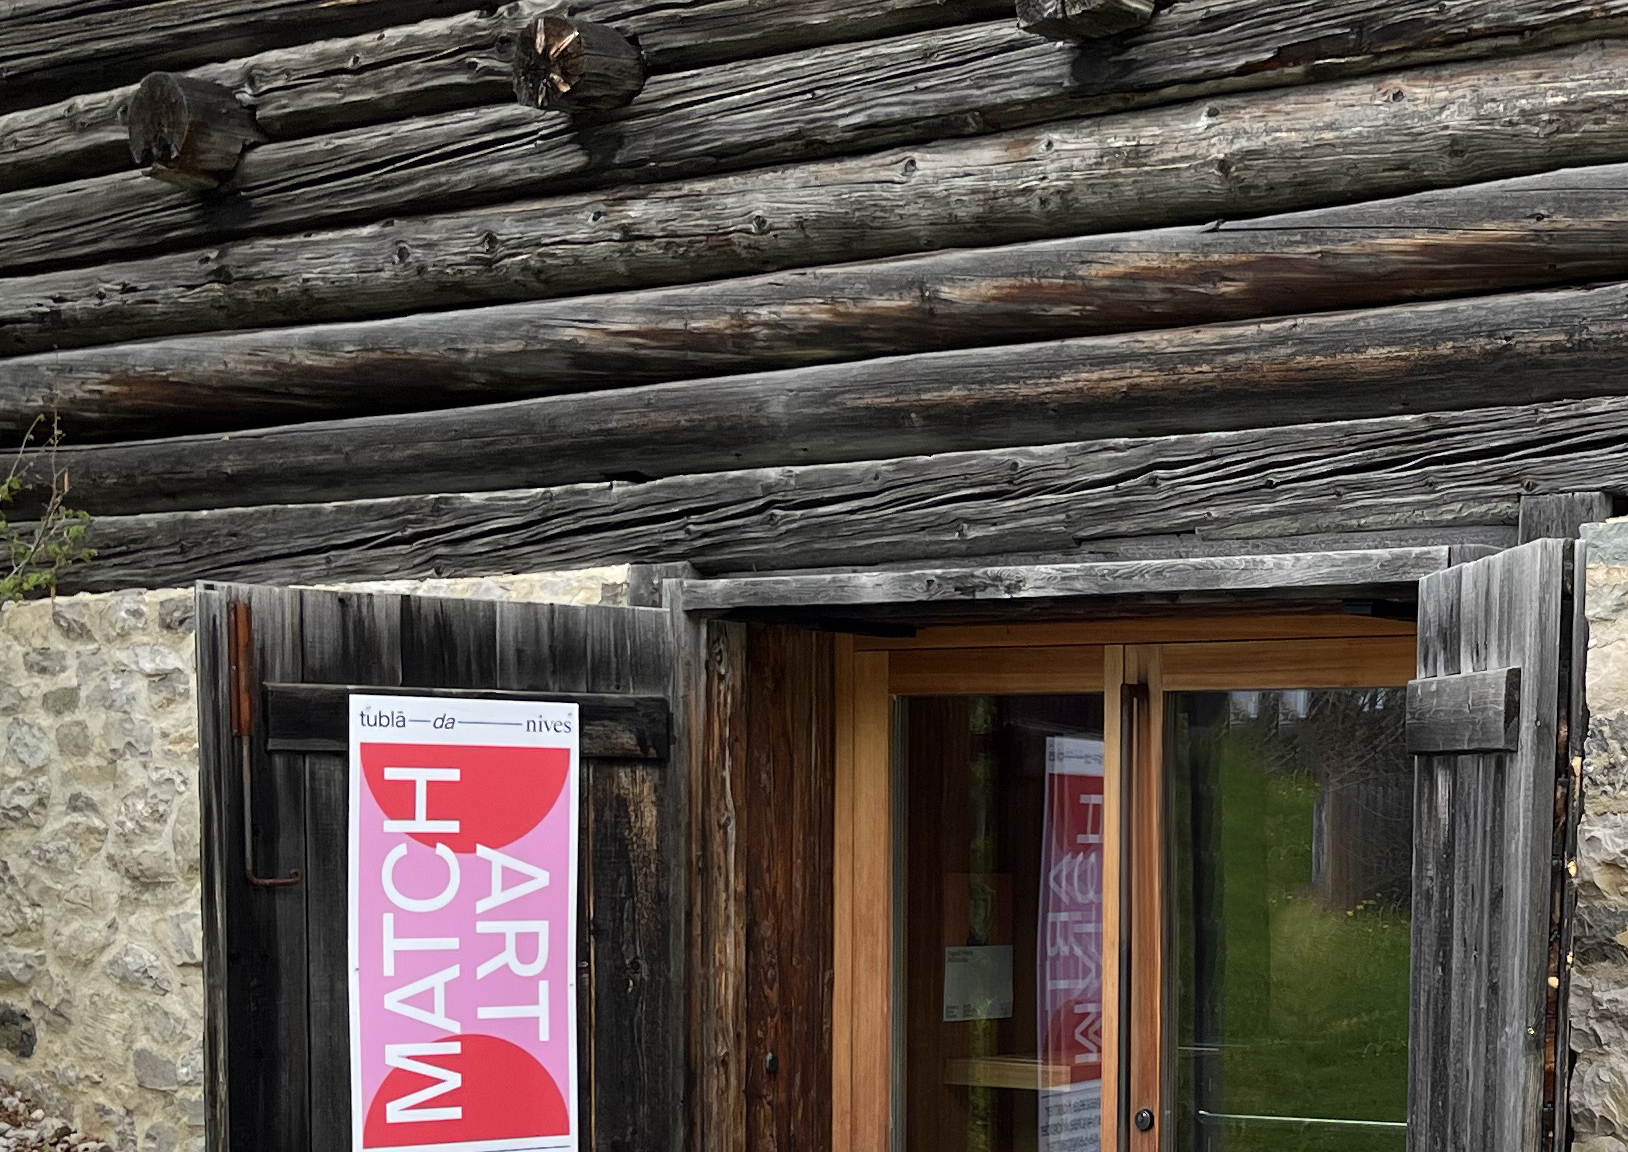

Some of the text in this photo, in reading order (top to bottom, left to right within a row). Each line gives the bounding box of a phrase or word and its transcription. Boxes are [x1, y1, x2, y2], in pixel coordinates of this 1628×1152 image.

[359, 710, 572, 733] tublā da nives
[381, 766, 462, 1124] MATCH
[475, 843, 550, 1042] ART
